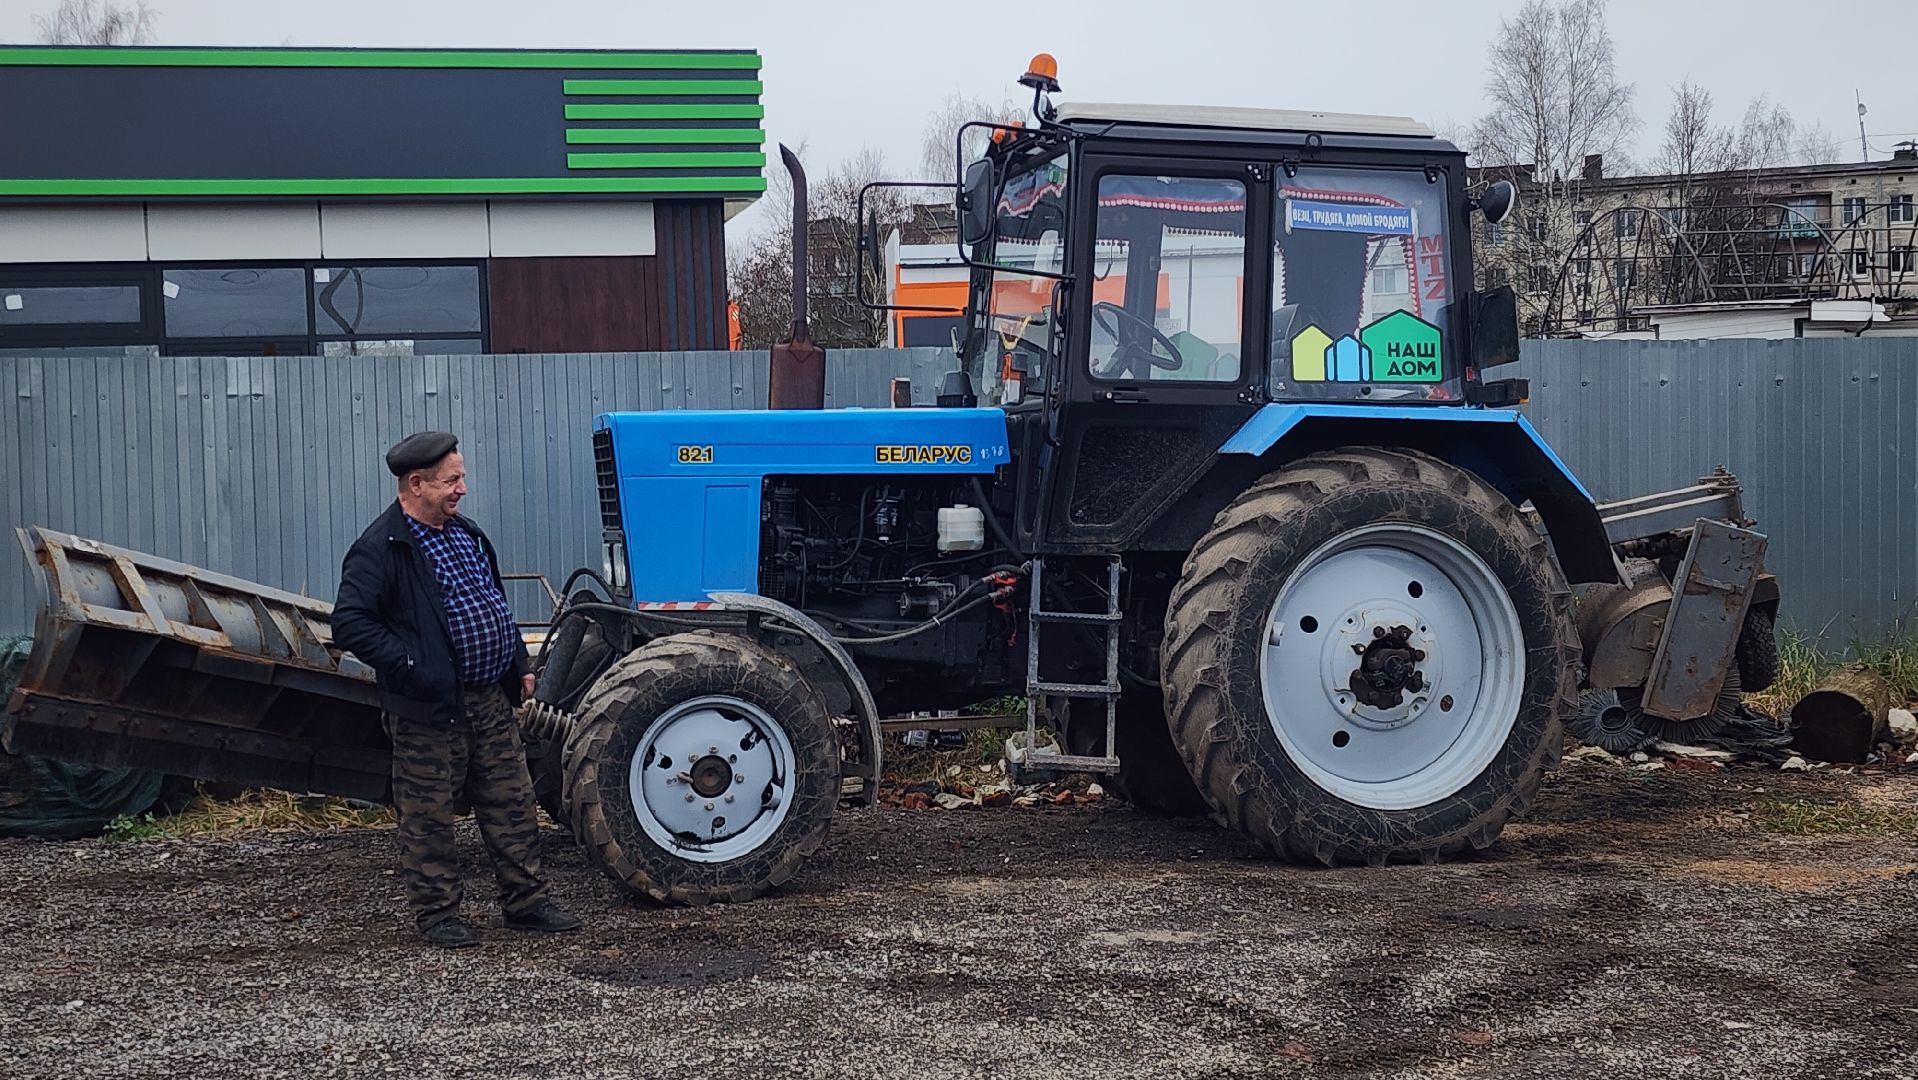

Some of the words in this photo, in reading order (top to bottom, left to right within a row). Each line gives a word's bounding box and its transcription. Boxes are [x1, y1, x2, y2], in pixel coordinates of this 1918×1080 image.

[1313, 211, 1344, 225] ТРУДЯГА,
[1346, 212, 1373, 227] ДОМОЙ
[1374, 215, 1409, 229] БРОДЯГУ!
[1387, 342, 1436, 358] НАШ
[1387, 360, 1437, 377] ДОМ
[678, 446, 713, 463] 82.1
[876, 446, 971, 464] БЕЛАРУС
